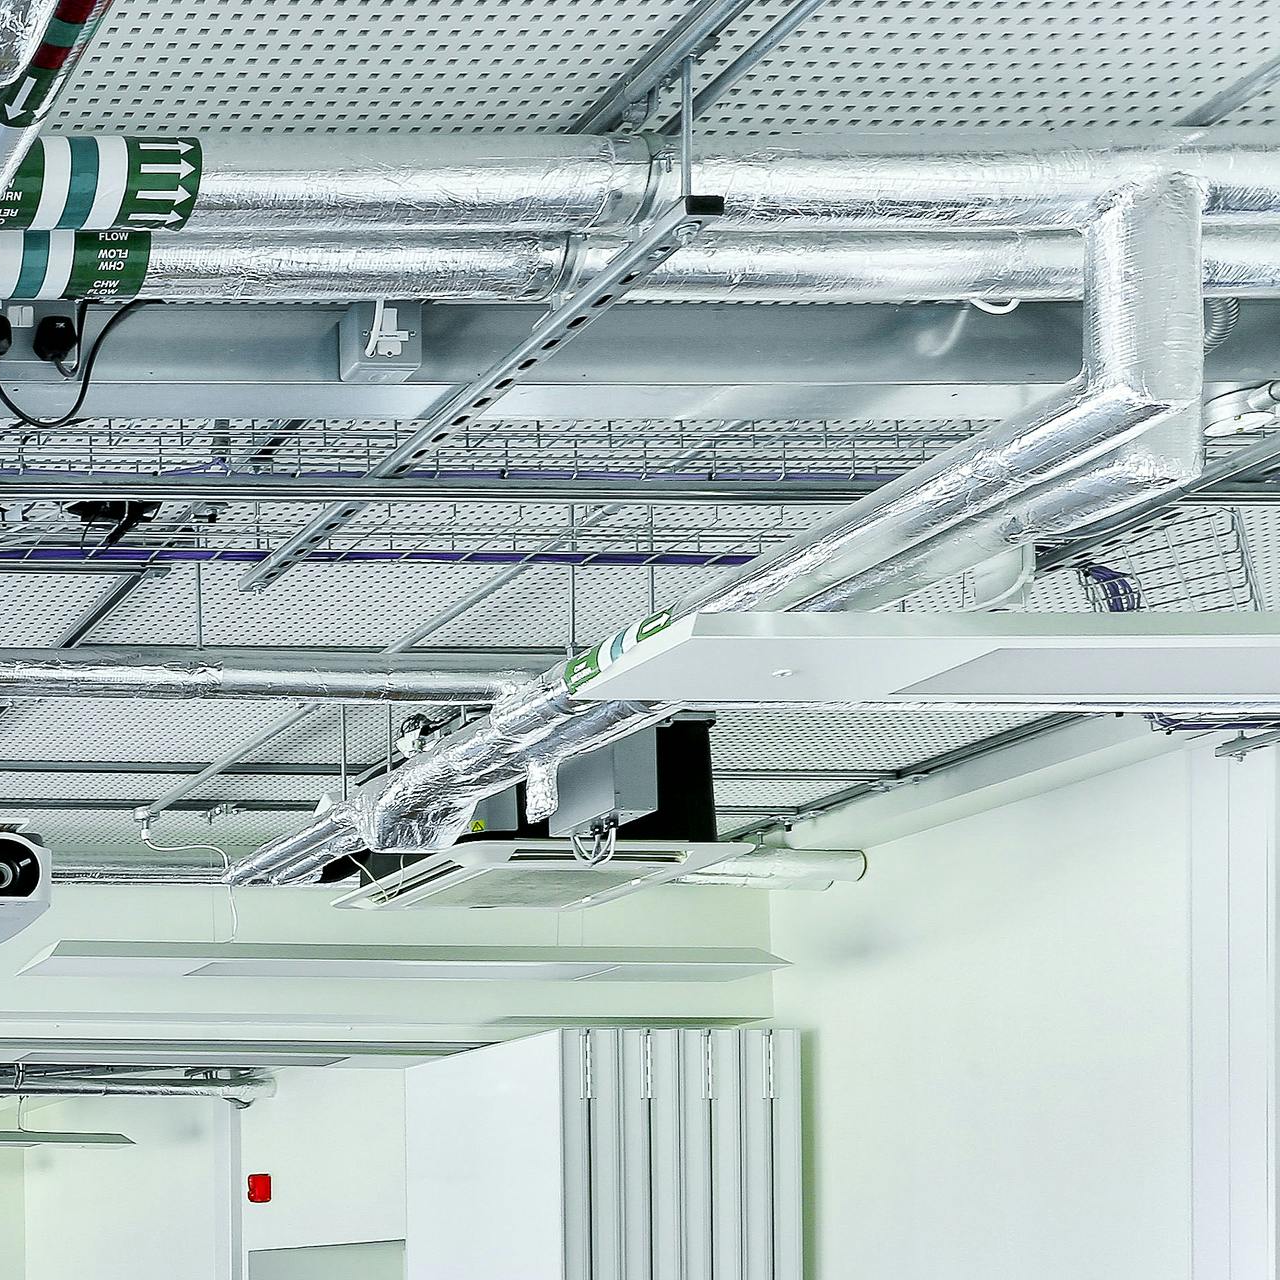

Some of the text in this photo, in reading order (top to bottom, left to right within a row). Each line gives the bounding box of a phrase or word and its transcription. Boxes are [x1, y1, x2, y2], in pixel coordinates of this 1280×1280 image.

[98, 232, 129, 241] FLOW
[97, 248, 129, 259] FLOW
[97, 260, 125, 271] CHW
[93, 280, 121, 288] CHW
